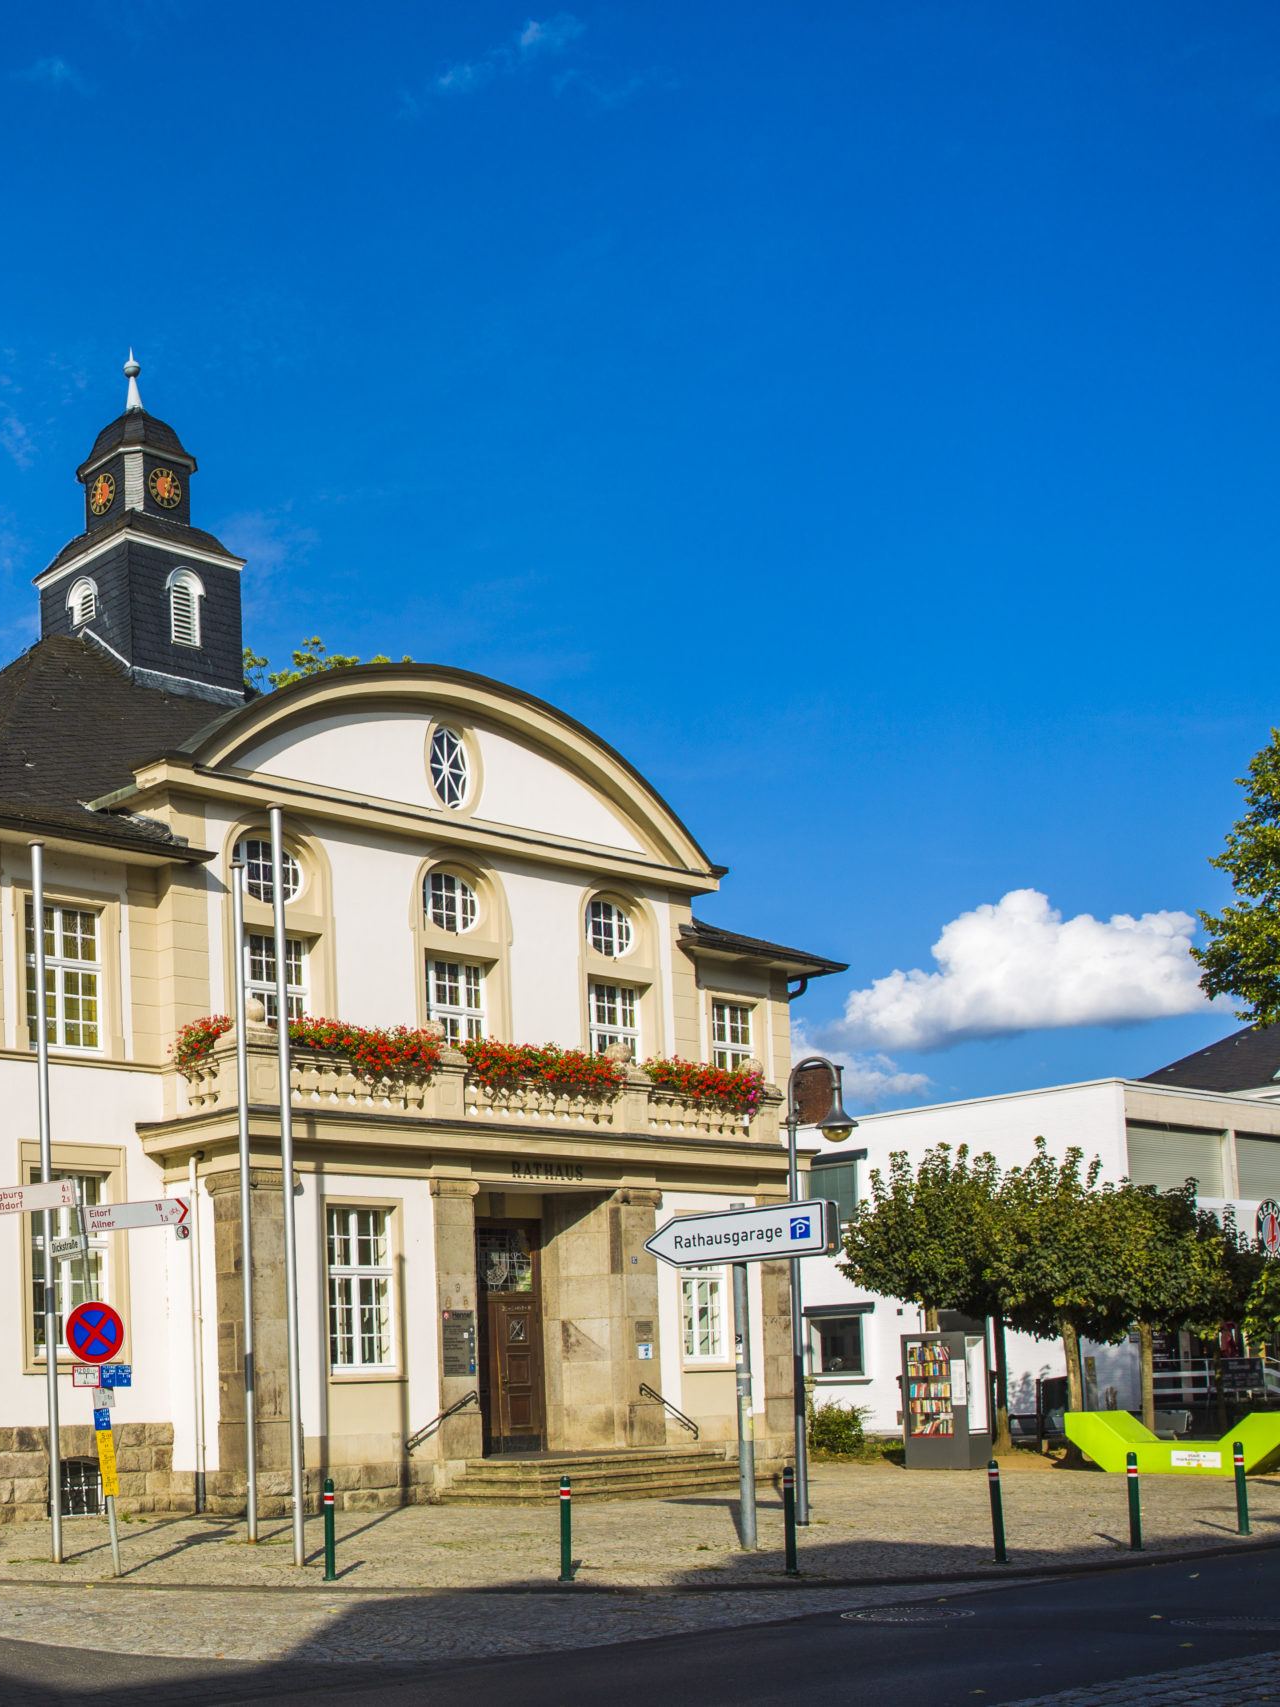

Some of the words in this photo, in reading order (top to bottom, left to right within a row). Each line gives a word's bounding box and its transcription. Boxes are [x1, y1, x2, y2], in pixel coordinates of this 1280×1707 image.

[511, 1161, 584, 1181] RATHAUS
[89, 1208, 112, 1218] Eitorf
[155, 1203, 163, 1212] 18
[91, 1220, 116, 1229] Allner
[796, 1224, 806, 1238] P
[674, 1226, 783, 1249] Rathausgarage
[51, 1239, 78, 1253] Dickstraße
